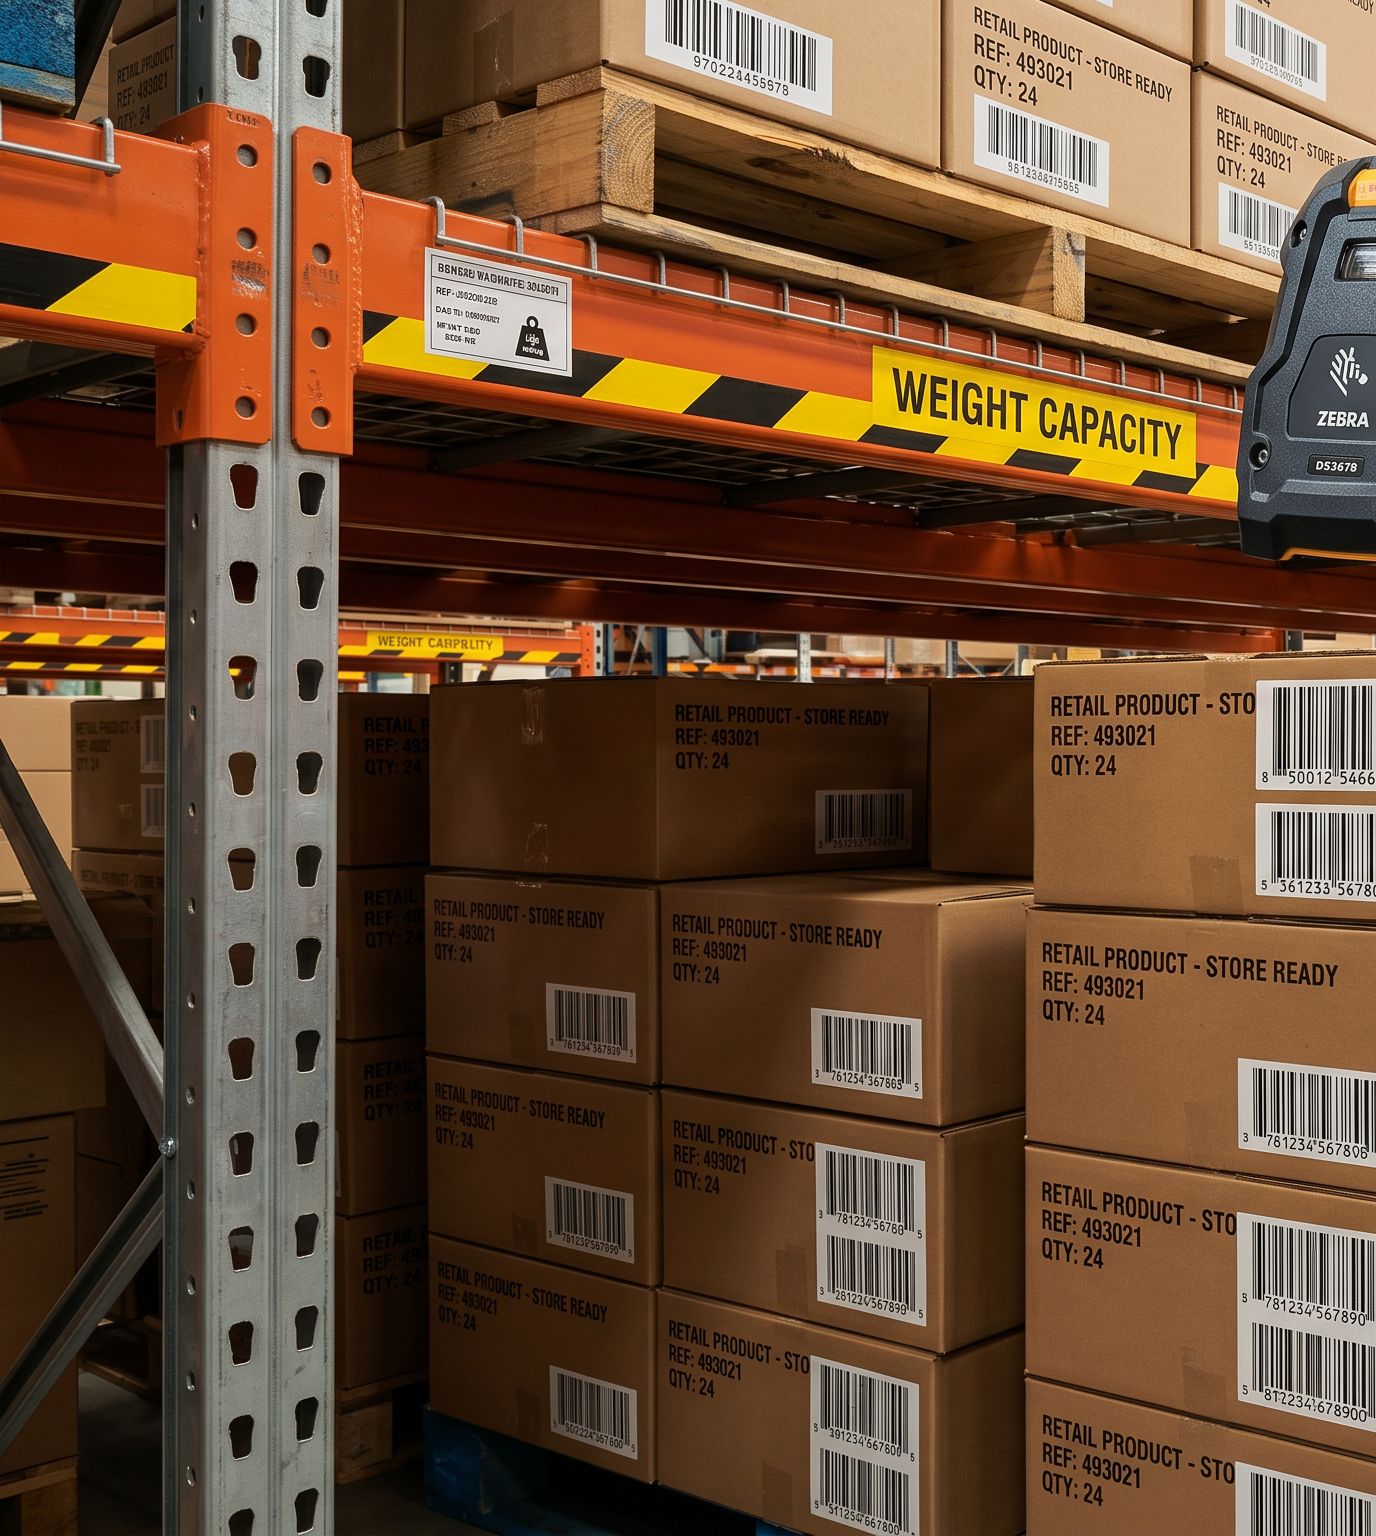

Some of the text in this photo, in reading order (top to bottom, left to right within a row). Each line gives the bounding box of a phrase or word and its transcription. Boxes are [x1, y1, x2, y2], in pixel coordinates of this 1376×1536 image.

[975, 7, 1020, 40] RETAIL
[1024, 27, 1082, 65] PRODUCT
[1095, 57, 1132, 86] STORE
[1136, 74, 1172, 102] READY
[975, 33, 1071, 90] REF: 493021
[974, 65, 1037, 106] QTY: 24
[1216, 105, 1251, 133] RETAIL
[1254, 121, 1298, 151] PRODUCT
[1307, 143, 1335, 166] STORE
[1217, 129, 1291, 173] REF: 493021
[1218, 155, 1265, 188] QTY: 24
[892, 367, 1181, 460] WEIGHT CAPACITY
[1316, 410, 1369, 428] ZEBRA
[378, 636, 423, 647] WEIGHT
[675, 704, 723, 722] RETAIL
[728, 706, 792, 724] PRODUCT
[804, 708, 845, 725] STORE
[849, 710, 889, 726] READY
[1051, 695, 1109, 716] RETAIL
[1116, 693, 1200, 715] PRODUCT
[1219, 691, 1256, 715] STO
[676, 728, 759, 746] REF: 493021
[1052, 725, 1154, 746] REF: 493021
[675, 752, 729, 769] QTY: 24
[1051, 755, 1116, 776] QTY: 24
[1261, 772, 1268, 783] 8
[1261, 880, 1268, 890] 5
[434, 899, 468, 918] RETAIL
[471, 902, 520, 922] PRODUCT
[529, 907, 564, 926] STORE
[567, 910, 604, 929] READY
[673, 914, 714, 934] RETAIL
[718, 918, 777, 939] PRODUCT
[790, 923, 832, 944] STORE
[837, 927, 882, 949] READY
[435, 943, 472, 963] QTY: 24
[673, 938, 699, 957] REF:
[673, 962, 720, 984] QTY: 24
[1043, 942, 1099, 967] RETAIL
[1105, 947, 1188, 974] PRODUCT
[1207, 955, 1266, 981] STORE
[1274, 960, 1338, 987] READY
[1043, 971, 1143, 1000] REF: 493021
[1043, 999, 1105, 1025] QTY: 24
[1042, 1182, 1097, 1211] RETAIL
[1103, 1192, 1184, 1225] PRODUCT
[1202, 1209, 1237, 1239] STO
[1042, 1209, 1140, 1247] REF: 493021
[1042, 1238, 1103, 1269] QTY: 24
[1043, 1415, 1097, 1448] RETAIL
[1103, 1430, 1182, 1469] PRODUCT
[1201, 1456, 1235, 1486] STO
[1043, 1442, 1140, 1488] REF: 493021
[1043, 1471, 1103, 1506] QTY: 24
